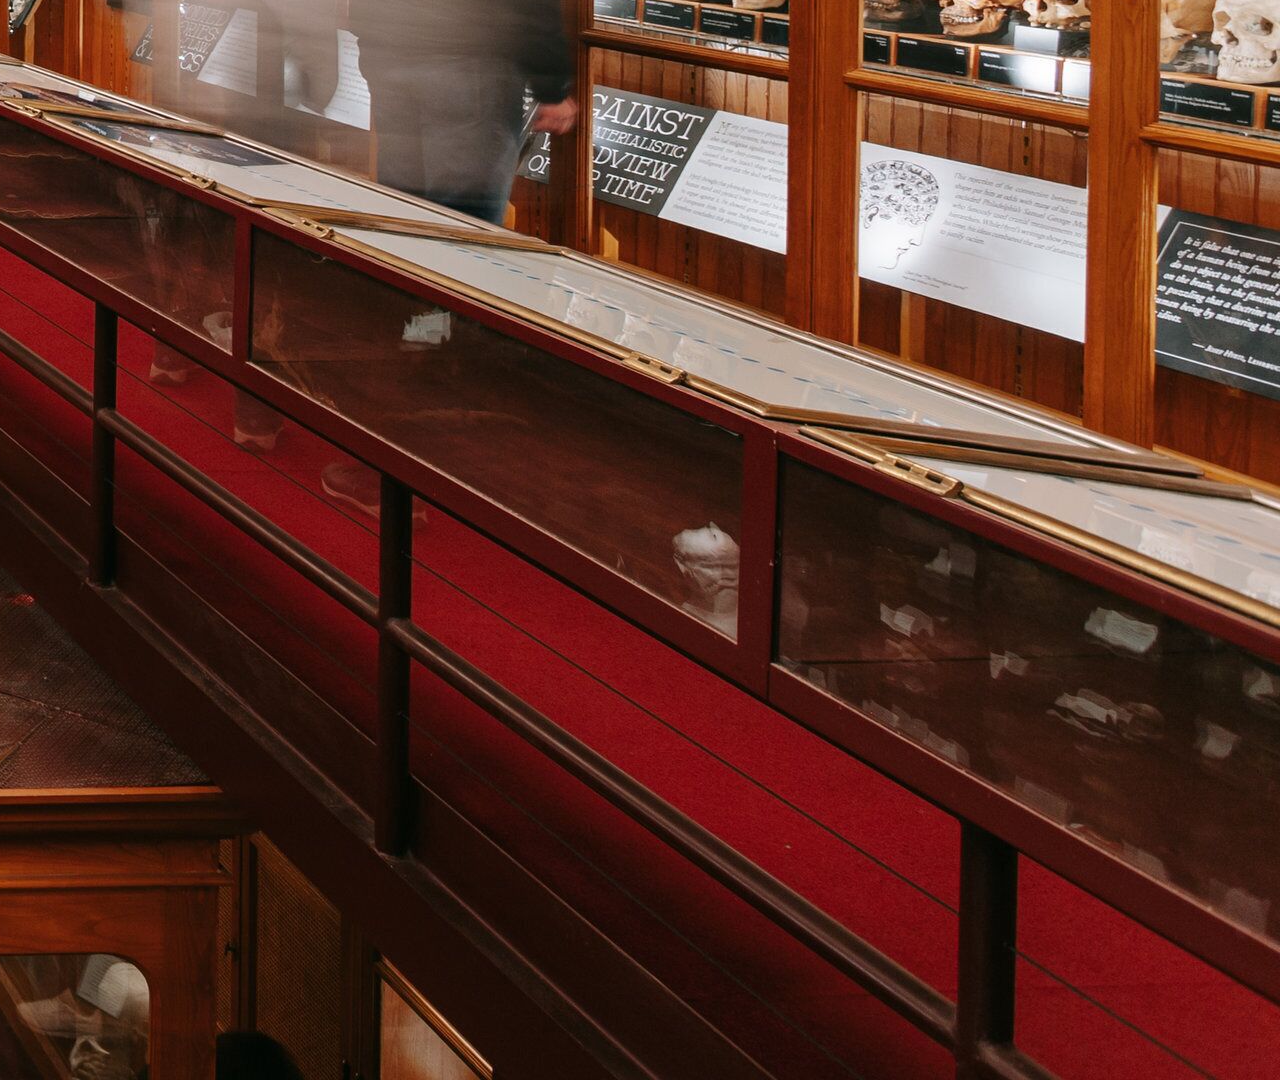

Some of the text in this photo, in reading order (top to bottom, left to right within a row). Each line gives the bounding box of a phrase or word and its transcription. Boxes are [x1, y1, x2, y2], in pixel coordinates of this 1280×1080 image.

[593, 145, 679, 182] DVIEW
[1183, 237, 1193, 245] It
[1193, 238, 1202, 247] is
[1221, 245, 1240, 256] that
[1169, 260, 1182, 269] do
[1182, 264, 1198, 273] not
[1197, 267, 1222, 279] object
[1221, 272, 1231, 281] to
[1231, 274, 1246, 285] the
[1177, 249, 1191, 259] of
[1195, 252, 1225, 266] human
[1225, 259, 1250, 274] being
[1246, 265, 1271, 277] from
[1163, 273, 1175, 281] on
[1175, 274, 1190, 284] the
[1190, 277, 1214, 292] brain,
[1215, 283, 1232, 295] but
[1231, 288, 1246, 298] the
[1165, 287, 1206, 304] puzzling
[1205, 295, 1224, 307] that
[1231, 301, 1267, 317] doctrine
[1179, 301, 1204, 317] being
[1203, 308, 1215, 320] by
[1215, 313, 1260, 332] measuring
[1258, 323, 1275, 334] the
